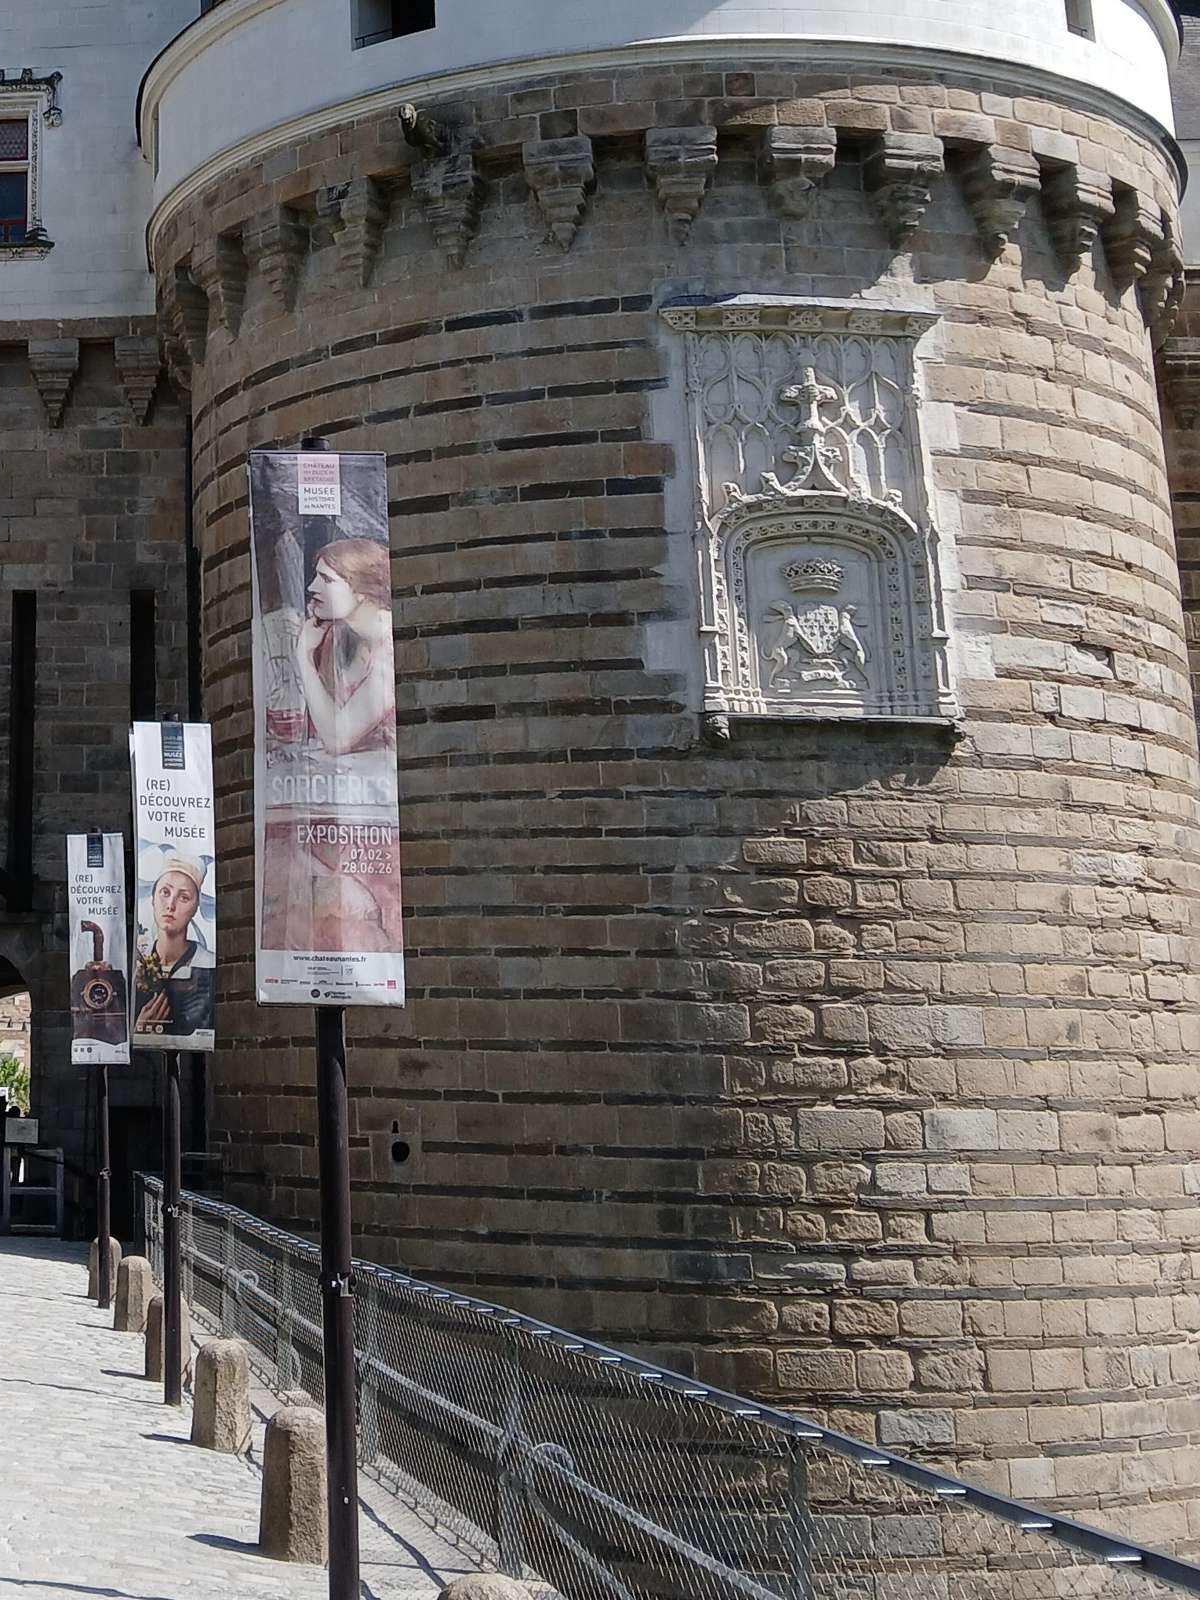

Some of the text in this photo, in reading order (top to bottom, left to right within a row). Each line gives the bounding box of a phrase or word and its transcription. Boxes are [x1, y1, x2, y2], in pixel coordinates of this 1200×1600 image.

[146, 778, 171, 791] (RE)
[271, 768, 391, 804] SORCIÈRES
[139, 793, 211, 808] DÉCOUVREZ
[147, 811, 186, 823] VOTRE
[164, 825, 206, 838] MUSÉE
[297, 825, 392, 845] EXPOSITION
[350, 849, 383, 860] 07.02
[343, 862, 392, 874] 28.06.26
[75, 874, 93, 883] (RE)
[70, 885, 121, 894] DÉCOUVREZ
[76, 897, 104, 905] VOTRE
[88, 905, 119, 915] MUSÉE
